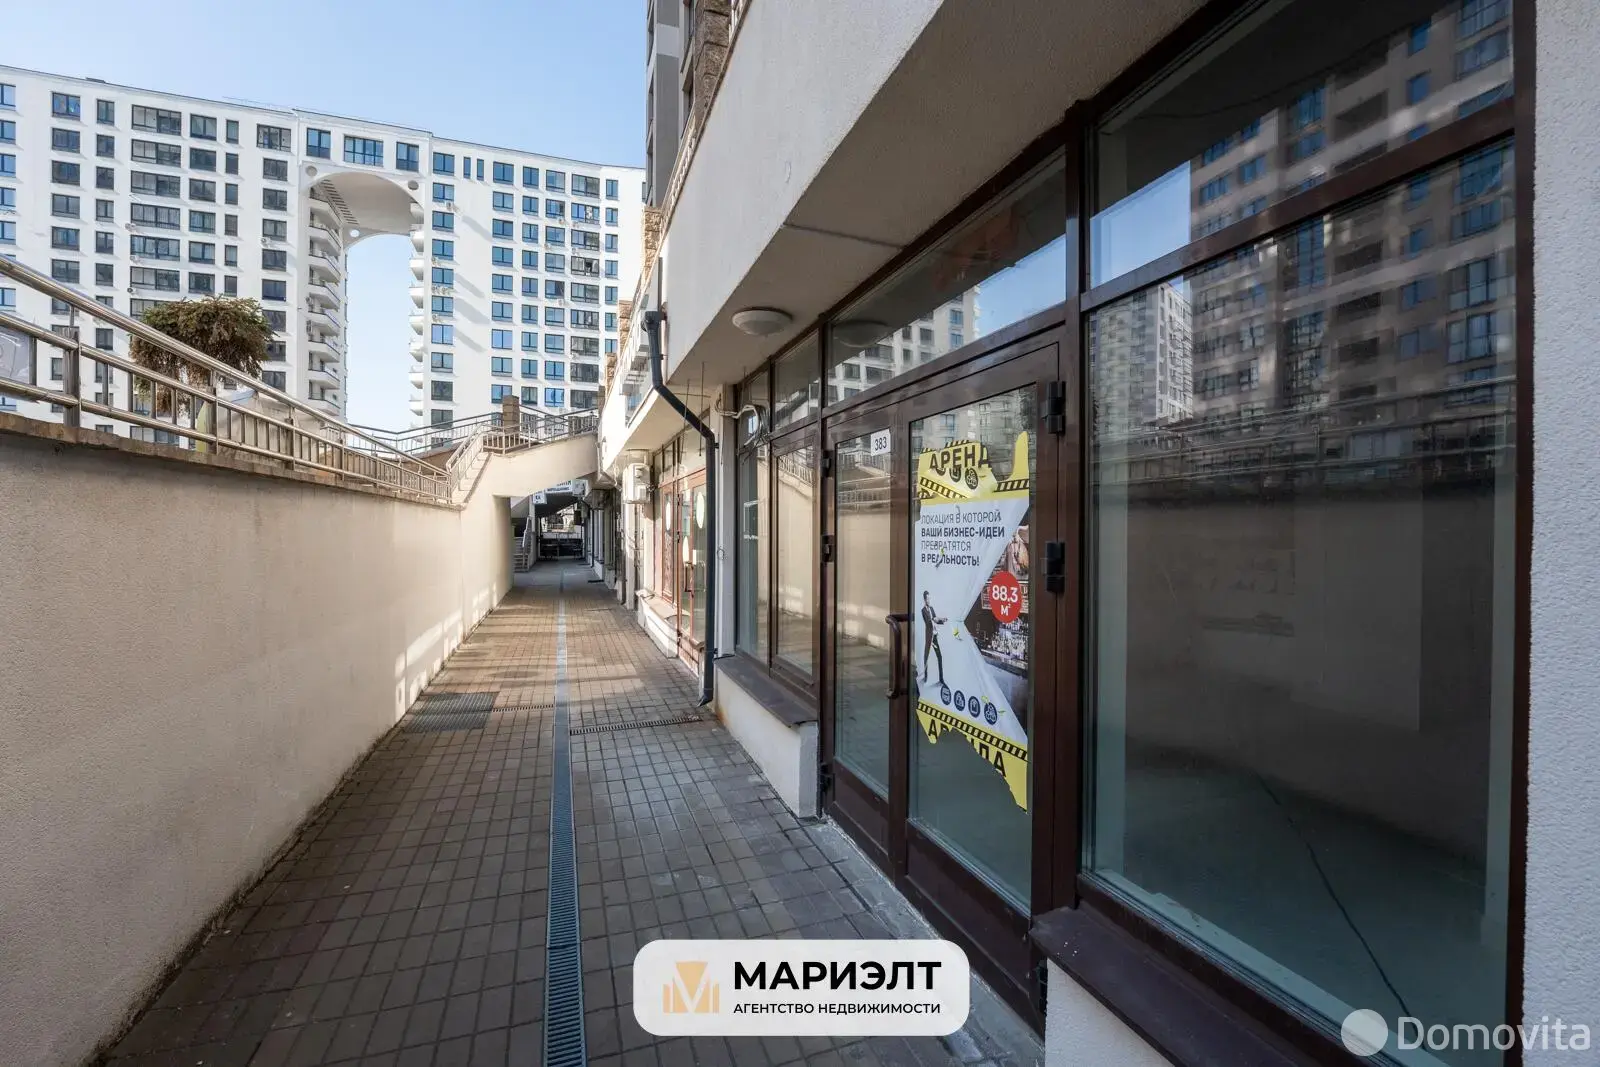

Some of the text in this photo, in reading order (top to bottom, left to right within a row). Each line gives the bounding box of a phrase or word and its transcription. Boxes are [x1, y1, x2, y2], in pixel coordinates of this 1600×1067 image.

[874, 437, 887, 451] 383
[920, 513, 953, 525] ЛОКАЦИЯ
[962, 509, 1001, 523] КОТОРОЙ
[921, 526, 1005, 539] ВАШИ БИЗНЕС-ИДЕИ
[921, 540, 971, 551] ПРЕВРАТЯТСЯ
[921, 553, 926, 562] В
[992, 585, 1018, 603] 88.3
